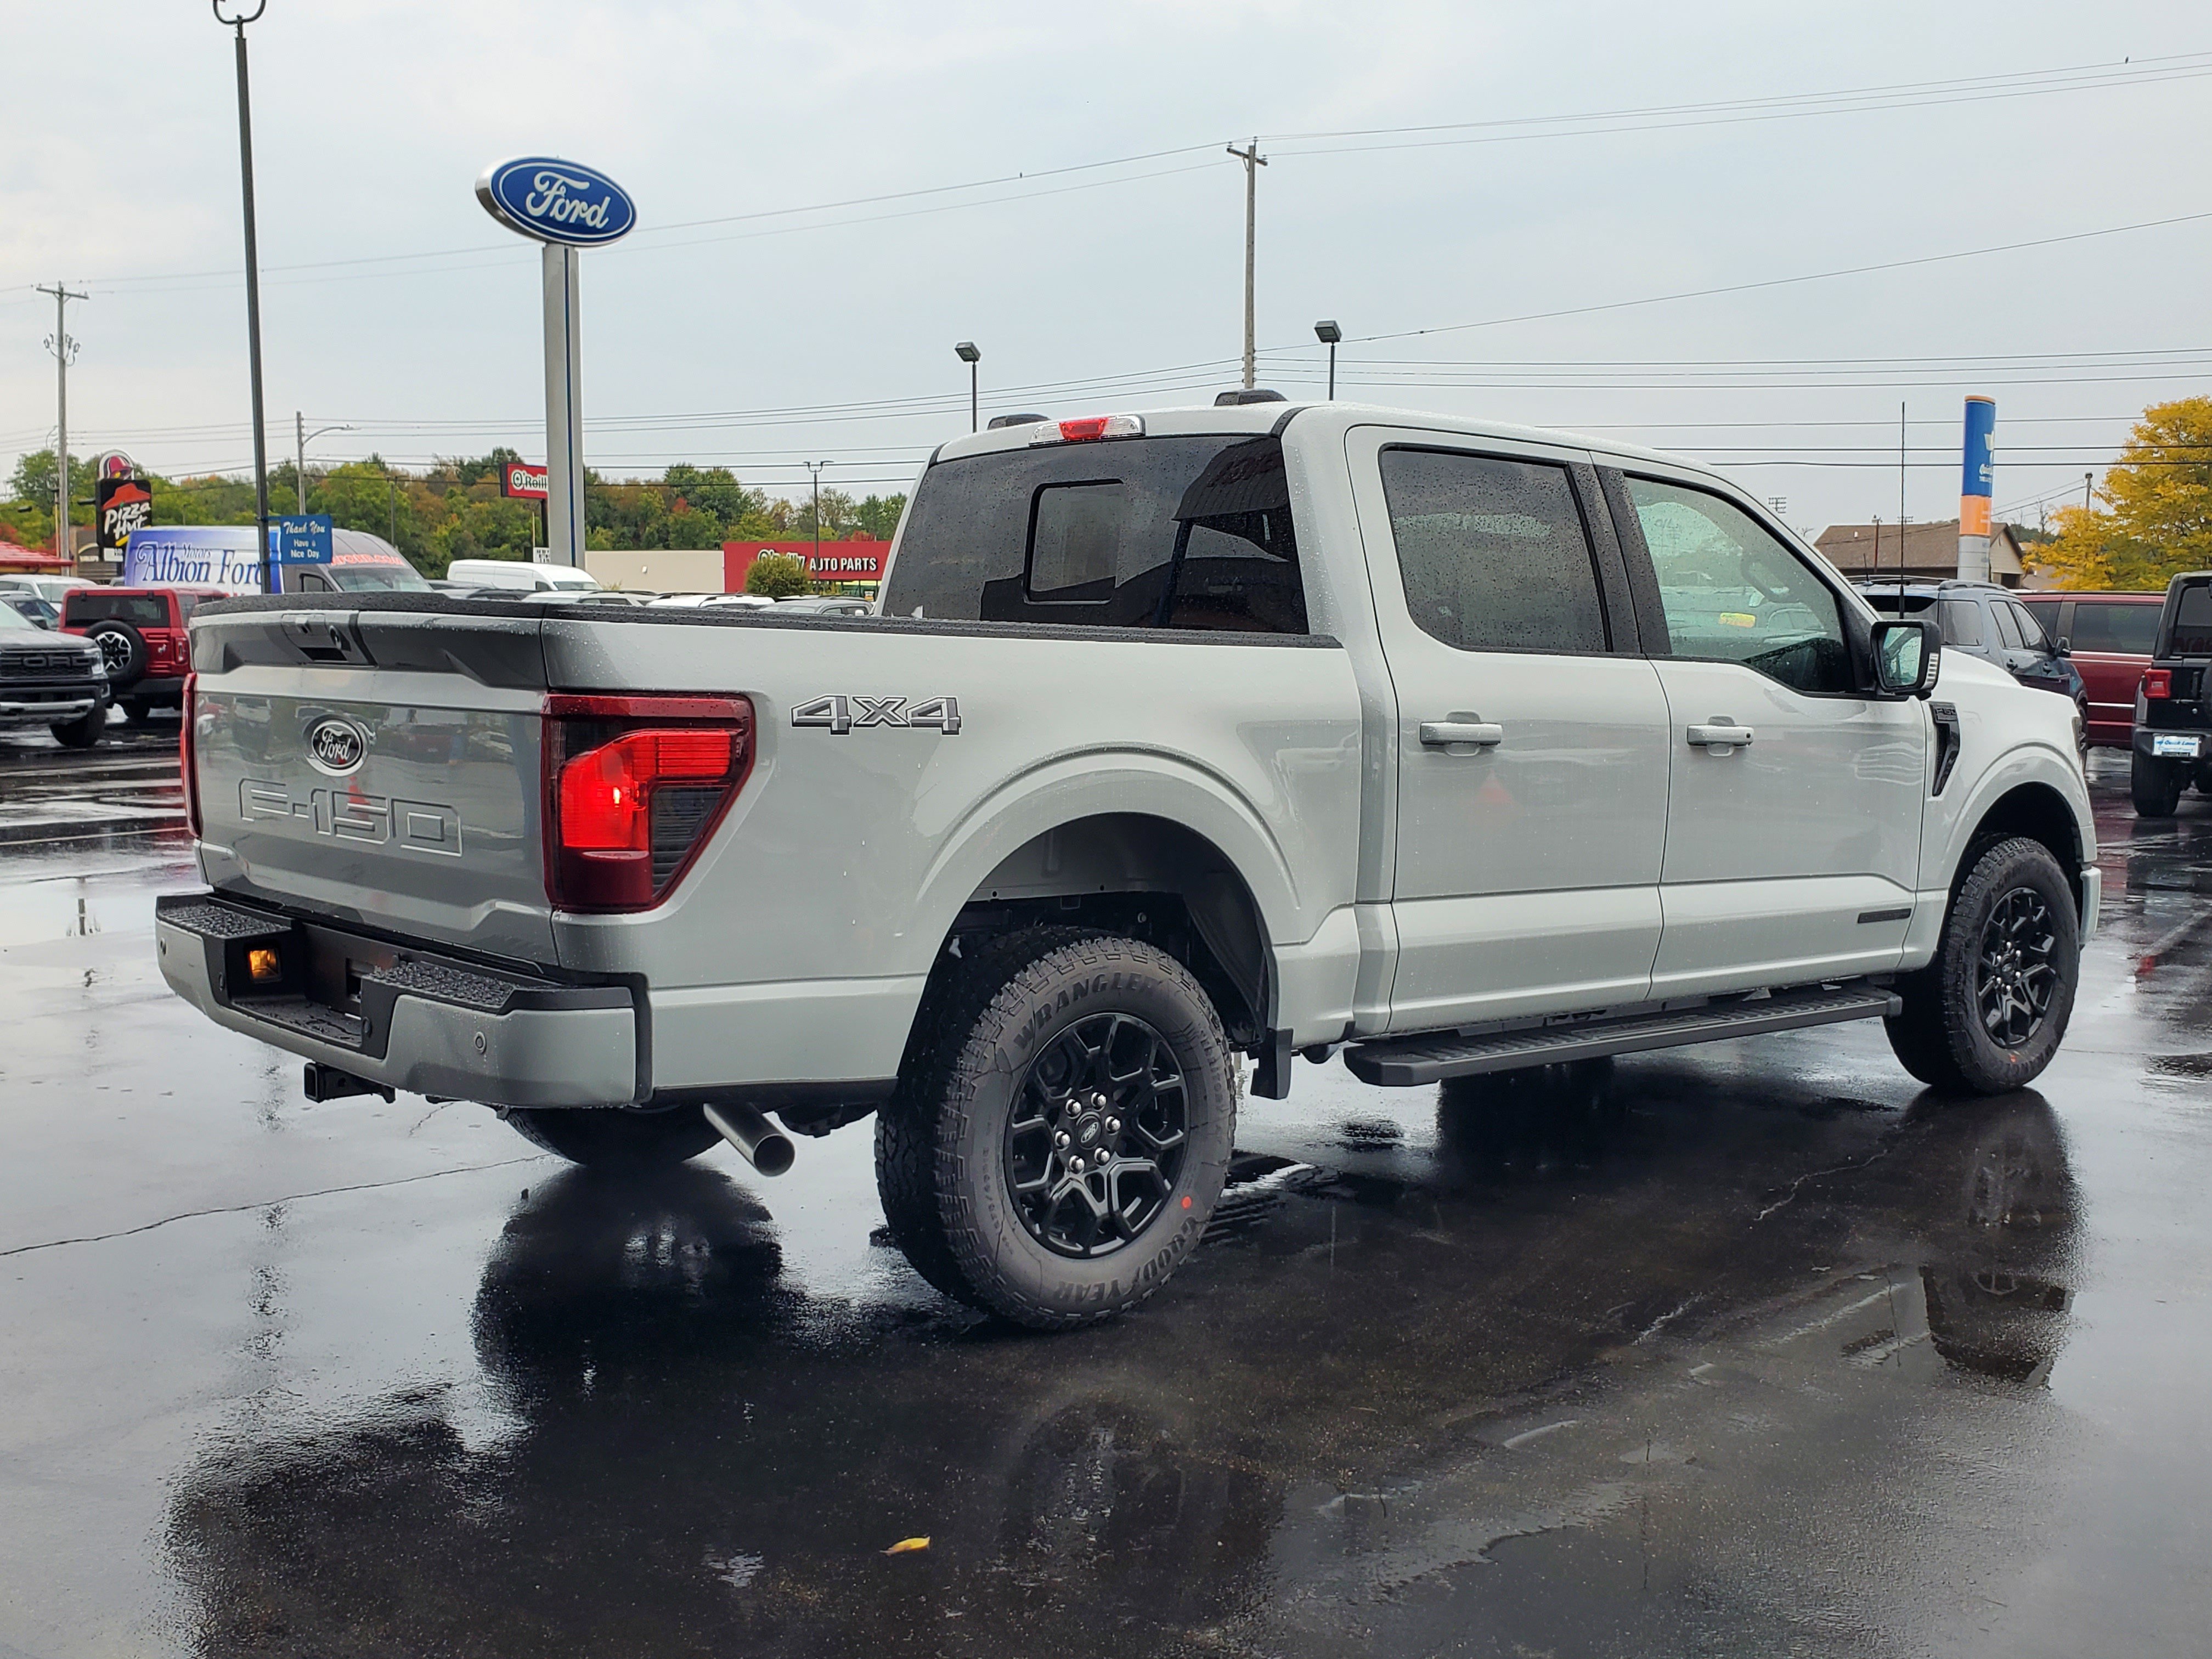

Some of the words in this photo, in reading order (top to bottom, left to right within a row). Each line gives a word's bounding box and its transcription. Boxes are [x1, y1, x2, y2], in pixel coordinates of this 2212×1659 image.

[526, 171, 611, 229] Ford
[512, 471, 548, 490] O'Reill
[104, 503, 151, 534] Pizza
[113, 515, 148, 540] Hut
[283, 521, 308, 534] Thank
[309, 521, 325, 535] You
[137, 542, 211, 582] Albion
[182, 544, 211, 559] Motors
[291, 549, 304, 558] Nice
[809, 557, 838, 571] AUTO
[840, 557, 877, 571] PARTS
[320, 727, 351, 760] Ford
[239, 778, 462, 857] F-150
[1014, 972, 1163, 1049] WRANGLER
